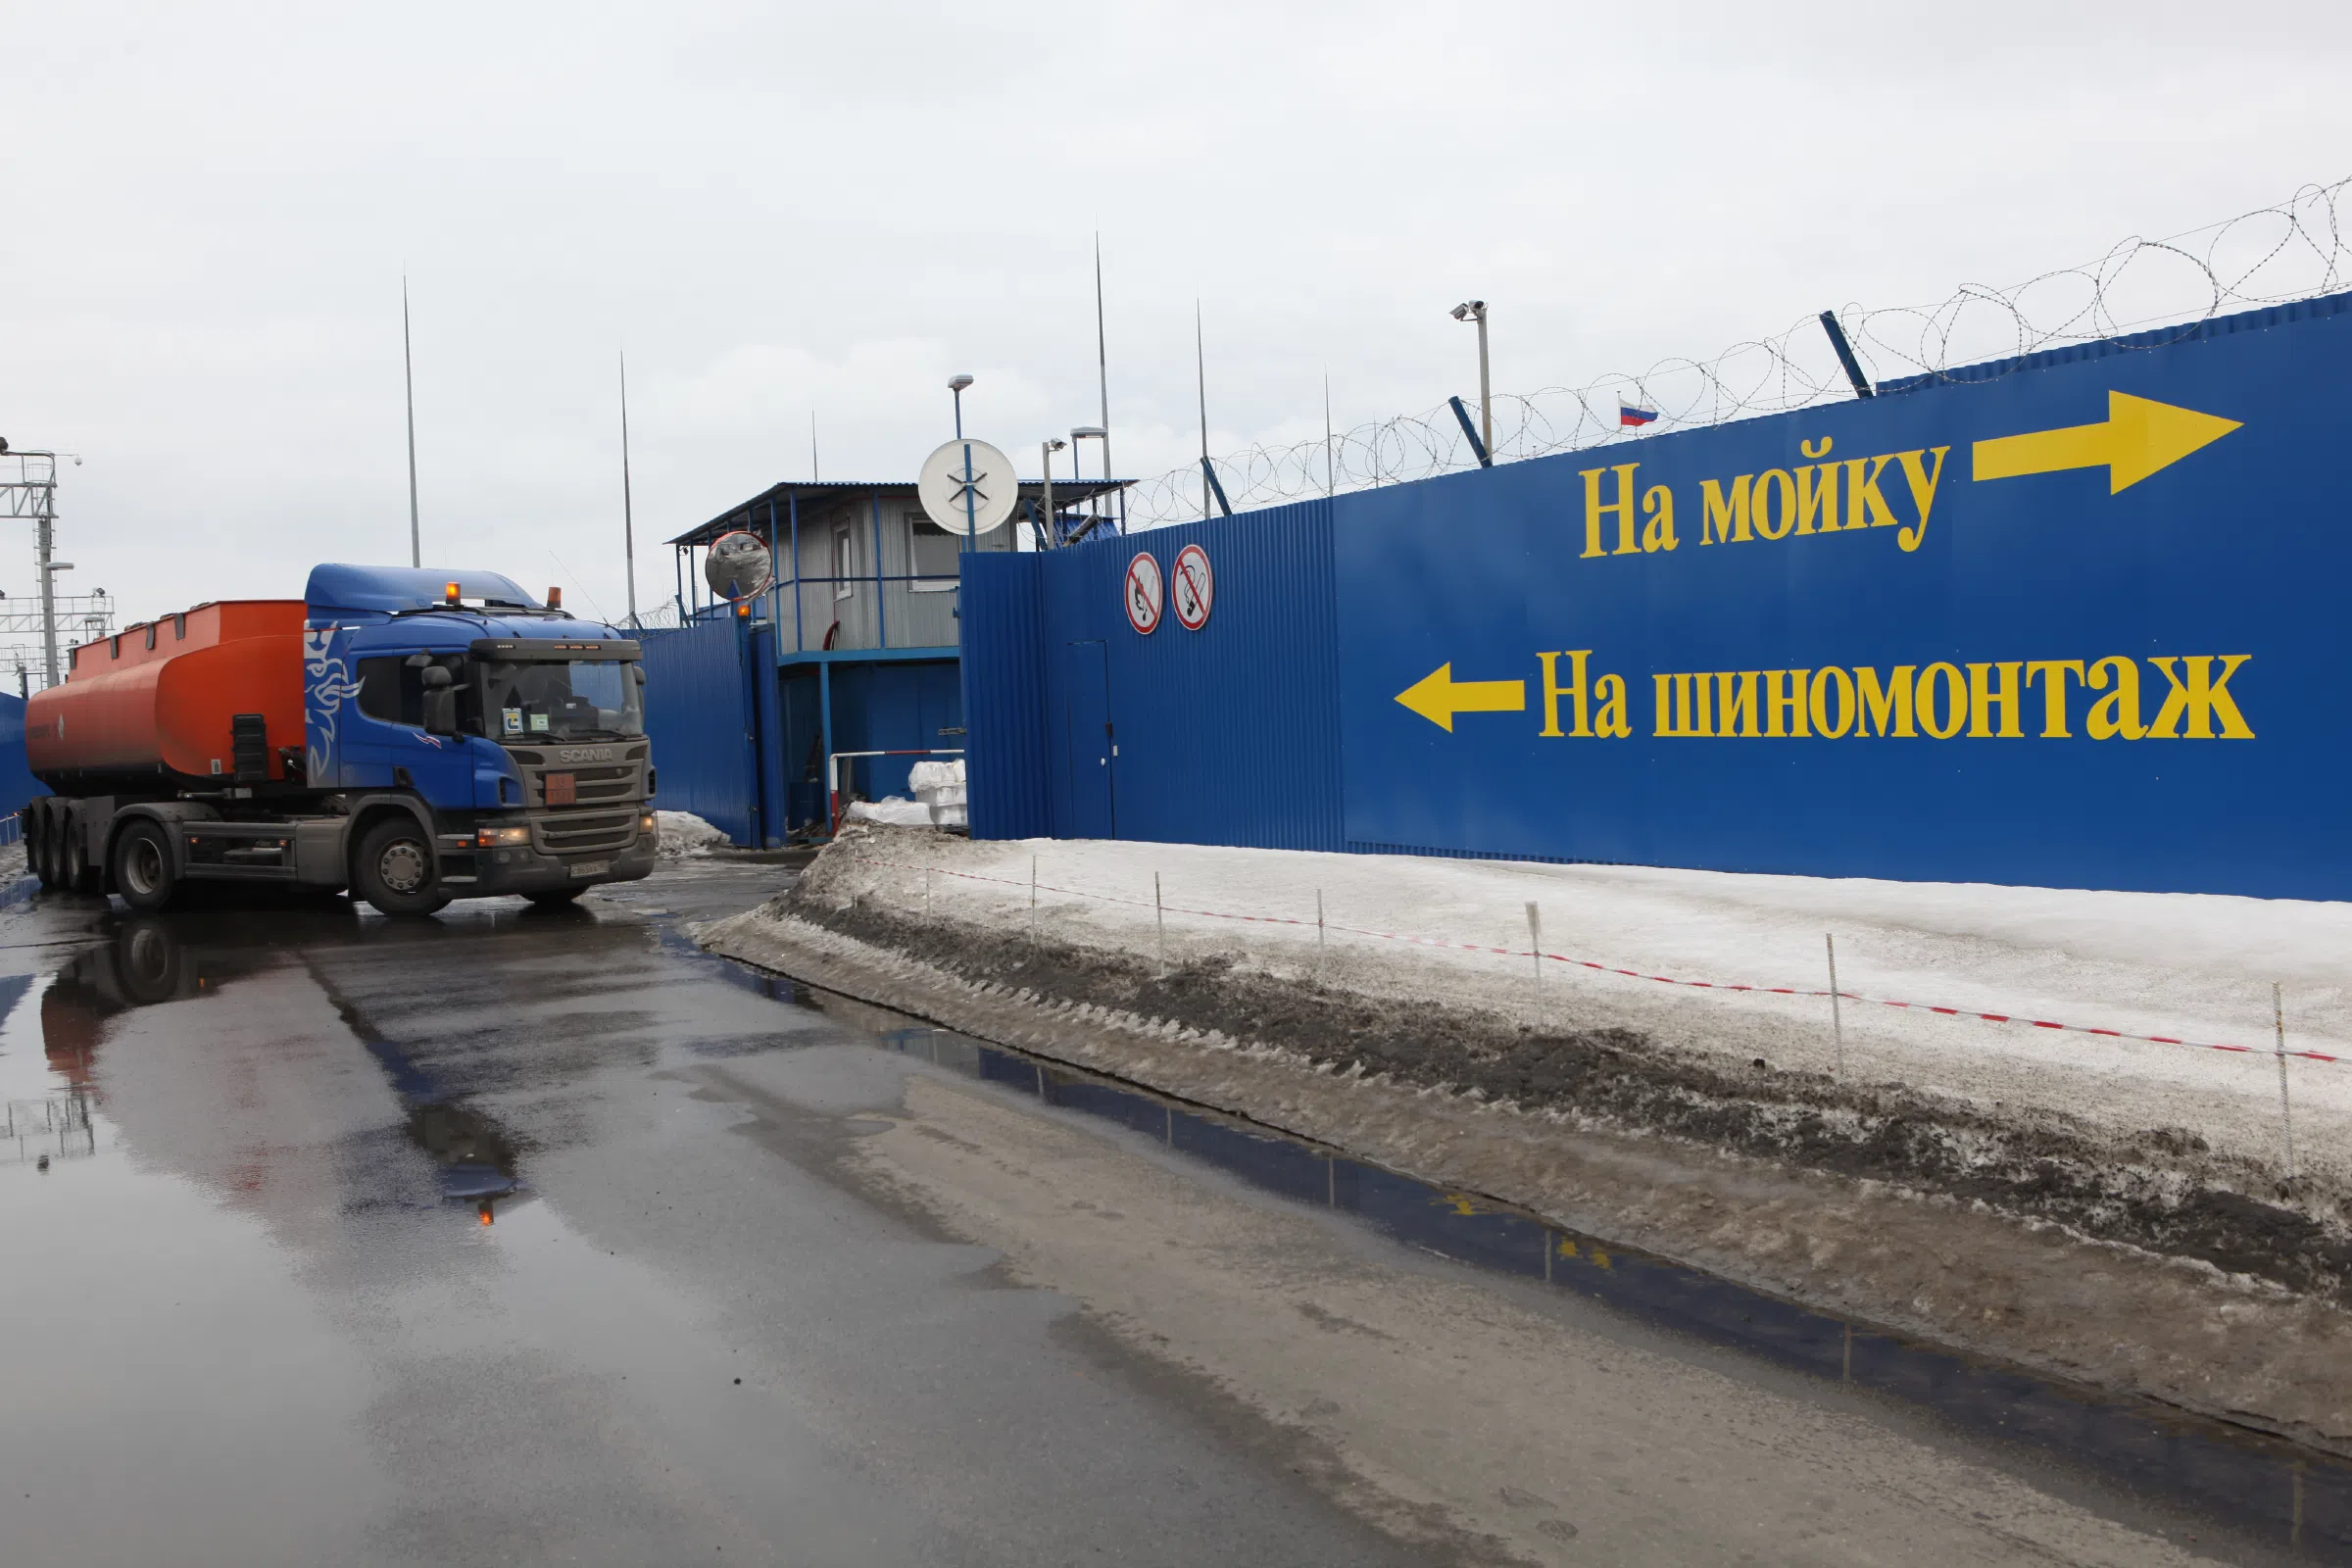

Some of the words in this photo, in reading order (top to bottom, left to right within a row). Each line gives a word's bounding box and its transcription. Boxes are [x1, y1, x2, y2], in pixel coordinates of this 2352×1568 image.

[1579, 463, 1680, 559] На
[1699, 436, 1951, 552] мойку
[1536, 650, 1633, 739] На
[1652, 654, 2256, 741] шиномонтаж
[560, 748, 613, 763] SCANIA
